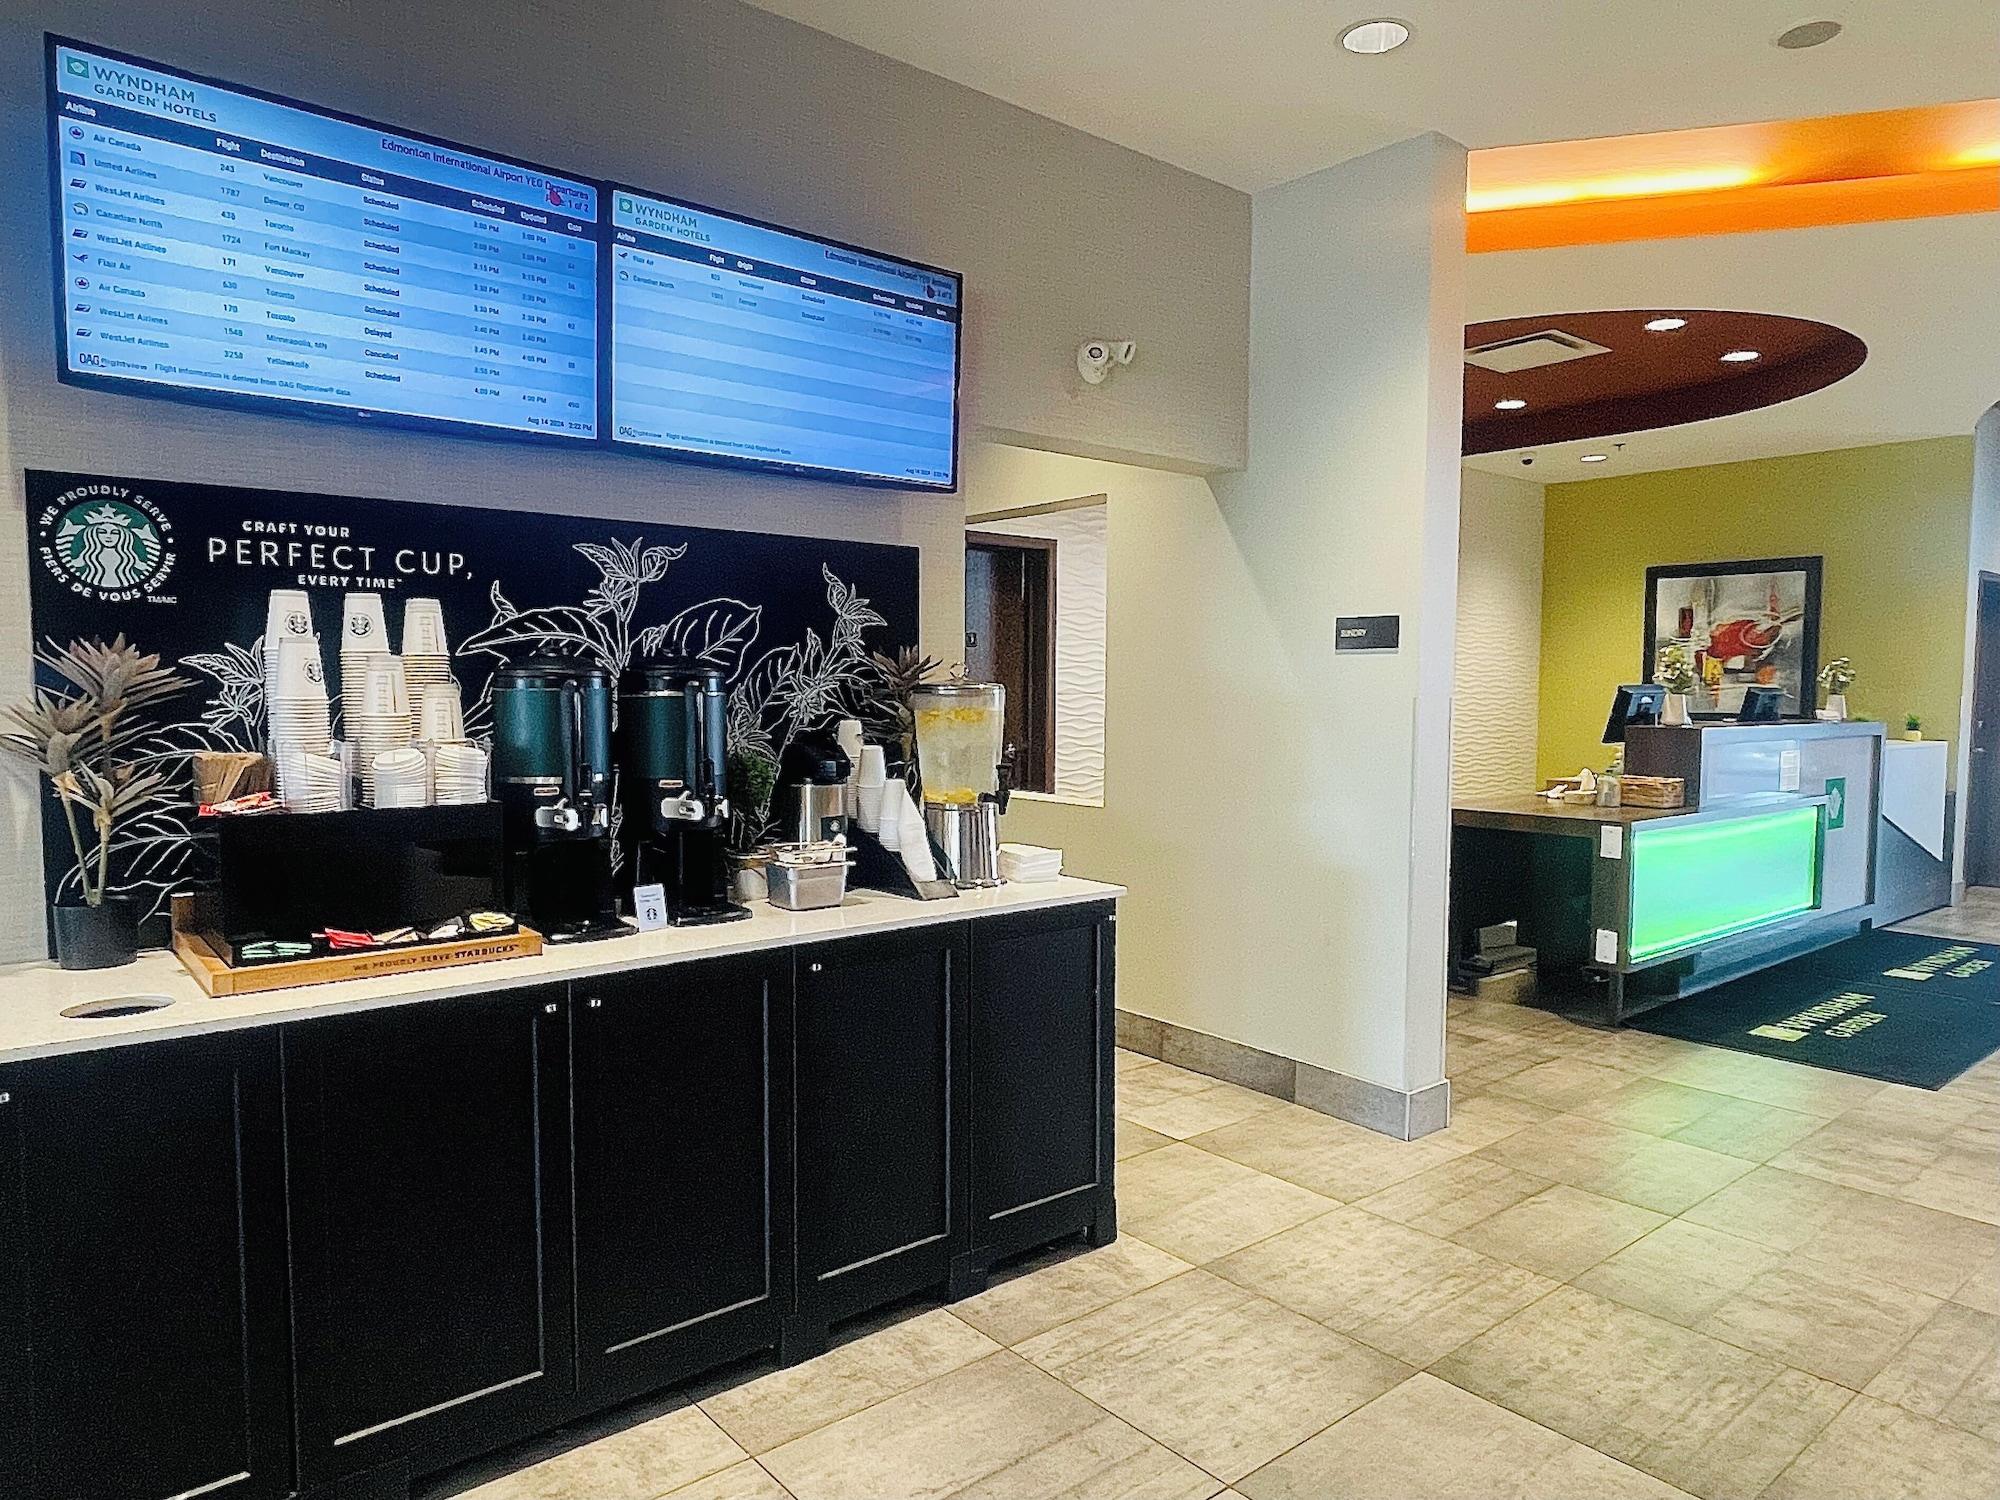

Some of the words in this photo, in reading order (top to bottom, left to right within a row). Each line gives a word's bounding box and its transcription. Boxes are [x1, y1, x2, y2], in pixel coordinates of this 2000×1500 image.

[93, 65, 195, 103] WYNDHAM
[163, 101, 217, 122] HOTELS
[93, 134, 106, 144] Air
[108, 137, 142, 152] Canada
[216, 138, 240, 152] Flight
[260, 148, 305, 167] Destination
[94, 158, 123, 172] United
[125, 165, 157, 179] Airlines
[219, 163, 235, 173] 243
[381, 139, 431, 161] Edmonton
[433, 152, 491, 175] International
[493, 168, 525, 184] Airport
[545, 180, 590, 201] Departures
[262, 173, 303, 189] Vancouver
[95, 184, 131, 199] WestJet
[133, 192, 166, 206] Airlines
[363, 195, 399, 210] Scheduled
[471, 199, 506, 215] Scheduled
[574, 202, 583, 211] of
[583, 204, 589, 213] 2
[95, 208, 137, 224] Canadian
[139, 217, 163, 229] North
[635, 203, 697, 228] WYNDHAM
[264, 218, 295, 232] Toronto
[363, 218, 399, 232] Scheduled
[634, 217, 673, 233] GARDEN
[676, 228, 711, 242] HOTELS
[96, 233, 133, 247] WestJet
[134, 239, 167, 254] Airlines
[221, 233, 241, 245] 1724
[264, 241, 281, 252] Fort
[363, 239, 400, 254] Scheduled
[97, 258, 117, 269] Flair
[119, 261, 131, 271] Air
[222, 256, 236, 267] 171
[709, 253, 725, 265] Flight
[264, 264, 305, 279] Vancouver
[363, 261, 400, 276] Scheduled
[98, 282, 111, 292] Air
[113, 285, 146, 298] Canada
[265, 288, 296, 300] Toronto
[363, 283, 400, 297] Scheduled
[99, 307, 135, 320] WestJet
[137, 313, 168, 326] Airlines
[265, 310, 296, 323] Toronto
[363, 305, 400, 318] Scheduled
[100, 331, 136, 344] WestJet
[137, 336, 170, 349] Airlines
[364, 327, 393, 339] Delayed
[79, 352, 100, 366] OAG
[364, 349, 399, 360] Cancelled
[154, 363, 177, 374] Flight
[266, 357, 310, 369] Yellowknife
[365, 370, 401, 383] Scheduled
[527, 416, 540, 425] Aug
[582, 423, 593, 431] PM
[39, 505, 59, 526] WE
[56, 484, 130, 506] PROUDLY
[134, 494, 172, 532] SERVE
[241, 520, 298, 534] CRAFT
[304, 523, 350, 538] YOUR
[208, 536, 376, 571] PERFECT
[395, 549, 473, 580] CUP,
[39, 546, 70, 583] FIERS
[71, 582, 93, 598] DE
[98, 588, 141, 602] VOUS
[143, 552, 176, 593] SERVIR
[297, 574, 350, 587] EVERY
[372, 957, 417, 969] PROUDLY
